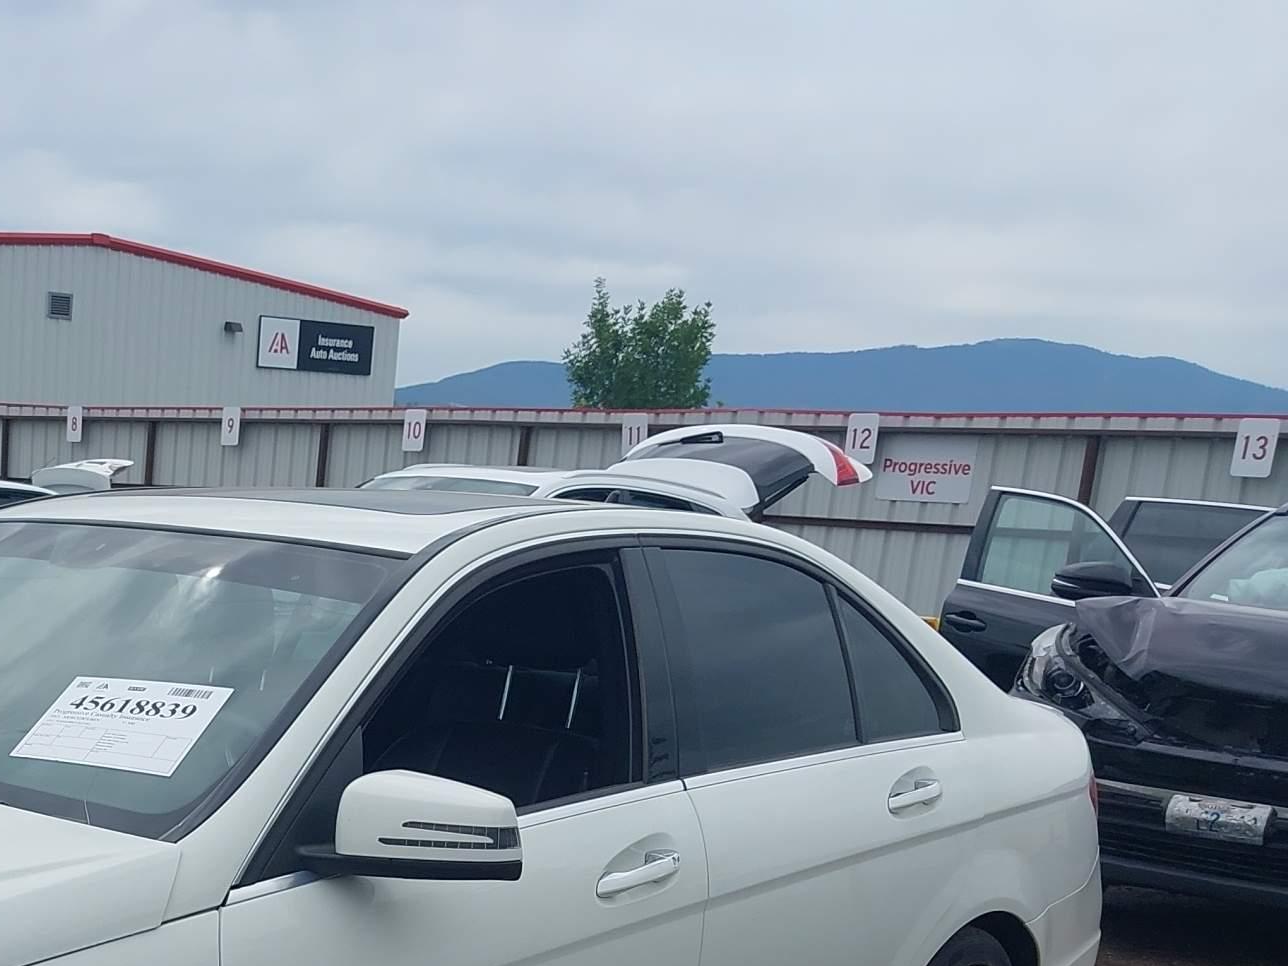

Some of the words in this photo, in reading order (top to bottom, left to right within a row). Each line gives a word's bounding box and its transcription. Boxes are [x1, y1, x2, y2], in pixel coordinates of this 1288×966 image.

[318, 334, 353, 348] Insurance
[310, 347, 328, 360] Auto
[328, 348, 359, 362] Auctions
[71, 416, 78, 432] 8
[226, 416, 234, 433] 9
[407, 420, 422, 440] 10
[628, 426, 641, 446] 11
[851, 428, 872, 449] 12
[1241, 435, 1269, 460] 13
[883, 458, 971, 476] Progressive
[910, 480, 937, 495] VIC
[69, 695, 198, 719] 45618839
